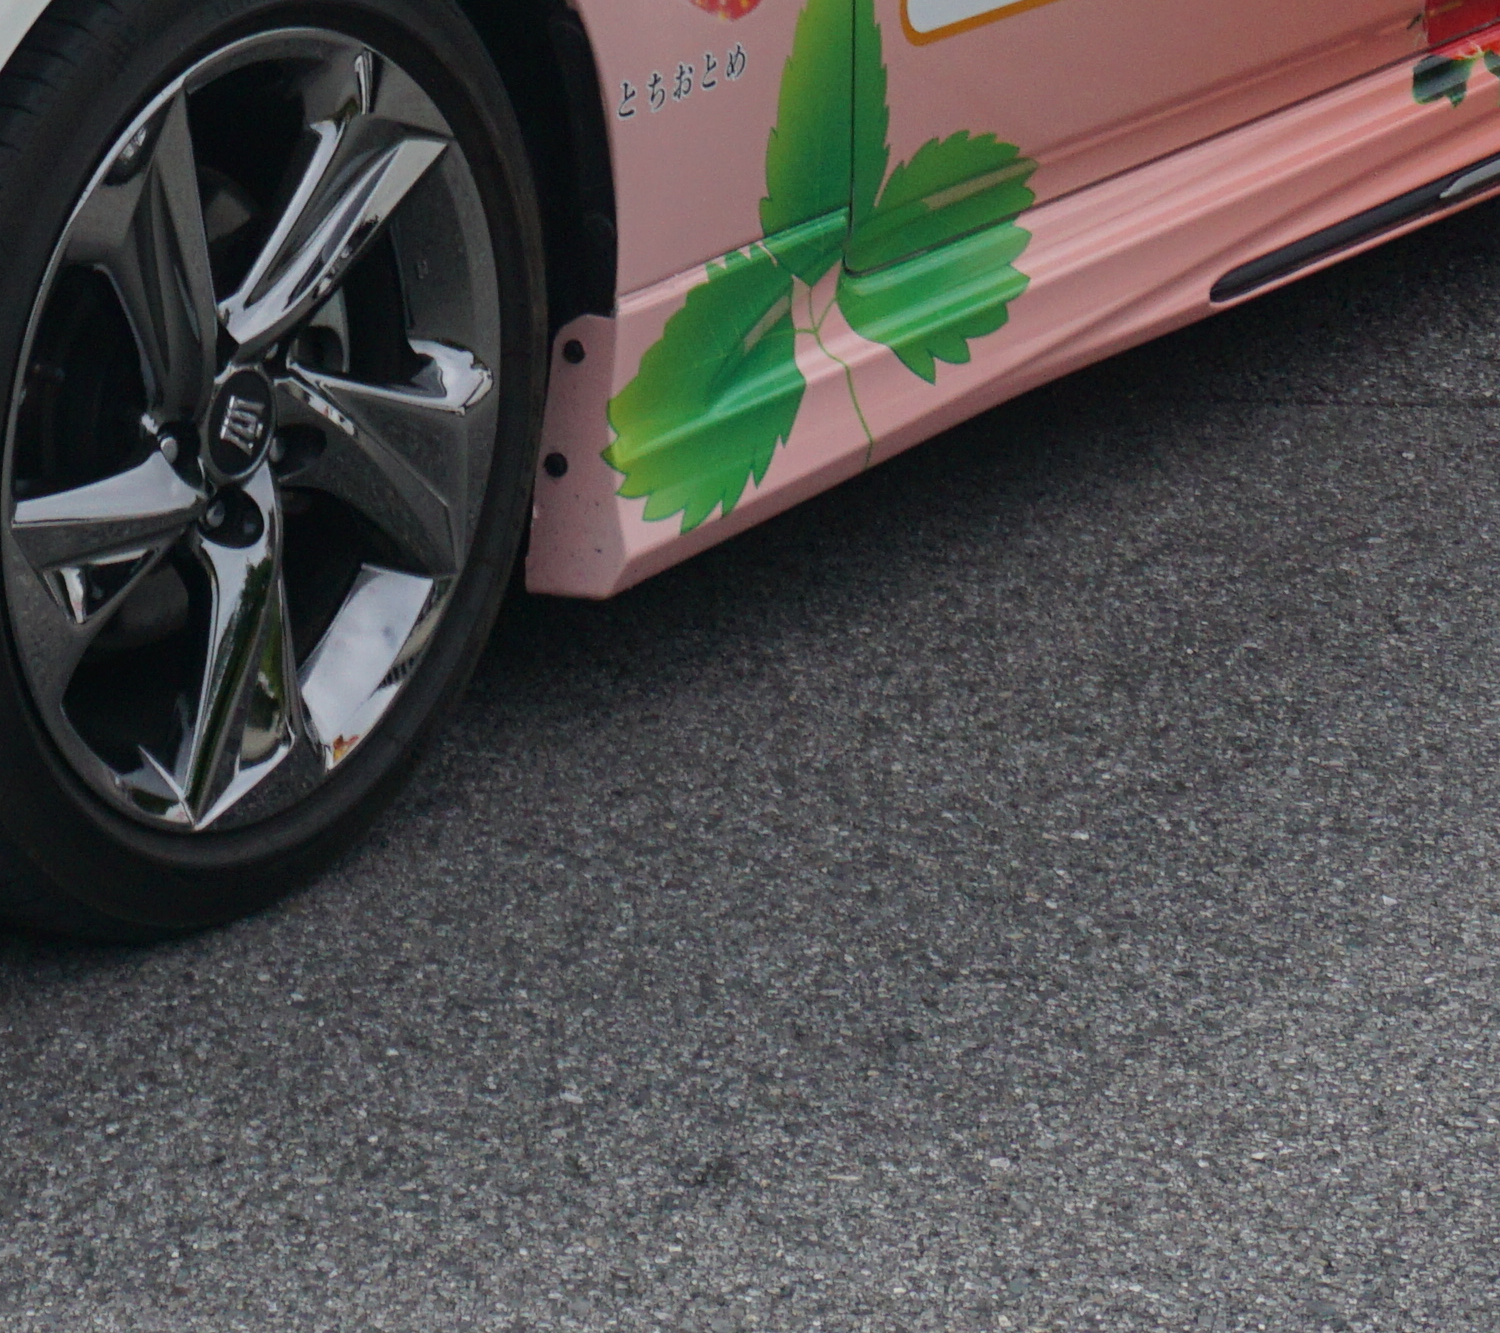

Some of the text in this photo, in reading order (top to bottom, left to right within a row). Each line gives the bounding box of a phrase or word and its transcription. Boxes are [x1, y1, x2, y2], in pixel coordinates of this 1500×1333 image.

[617, 42, 746, 120] とちおとめ
